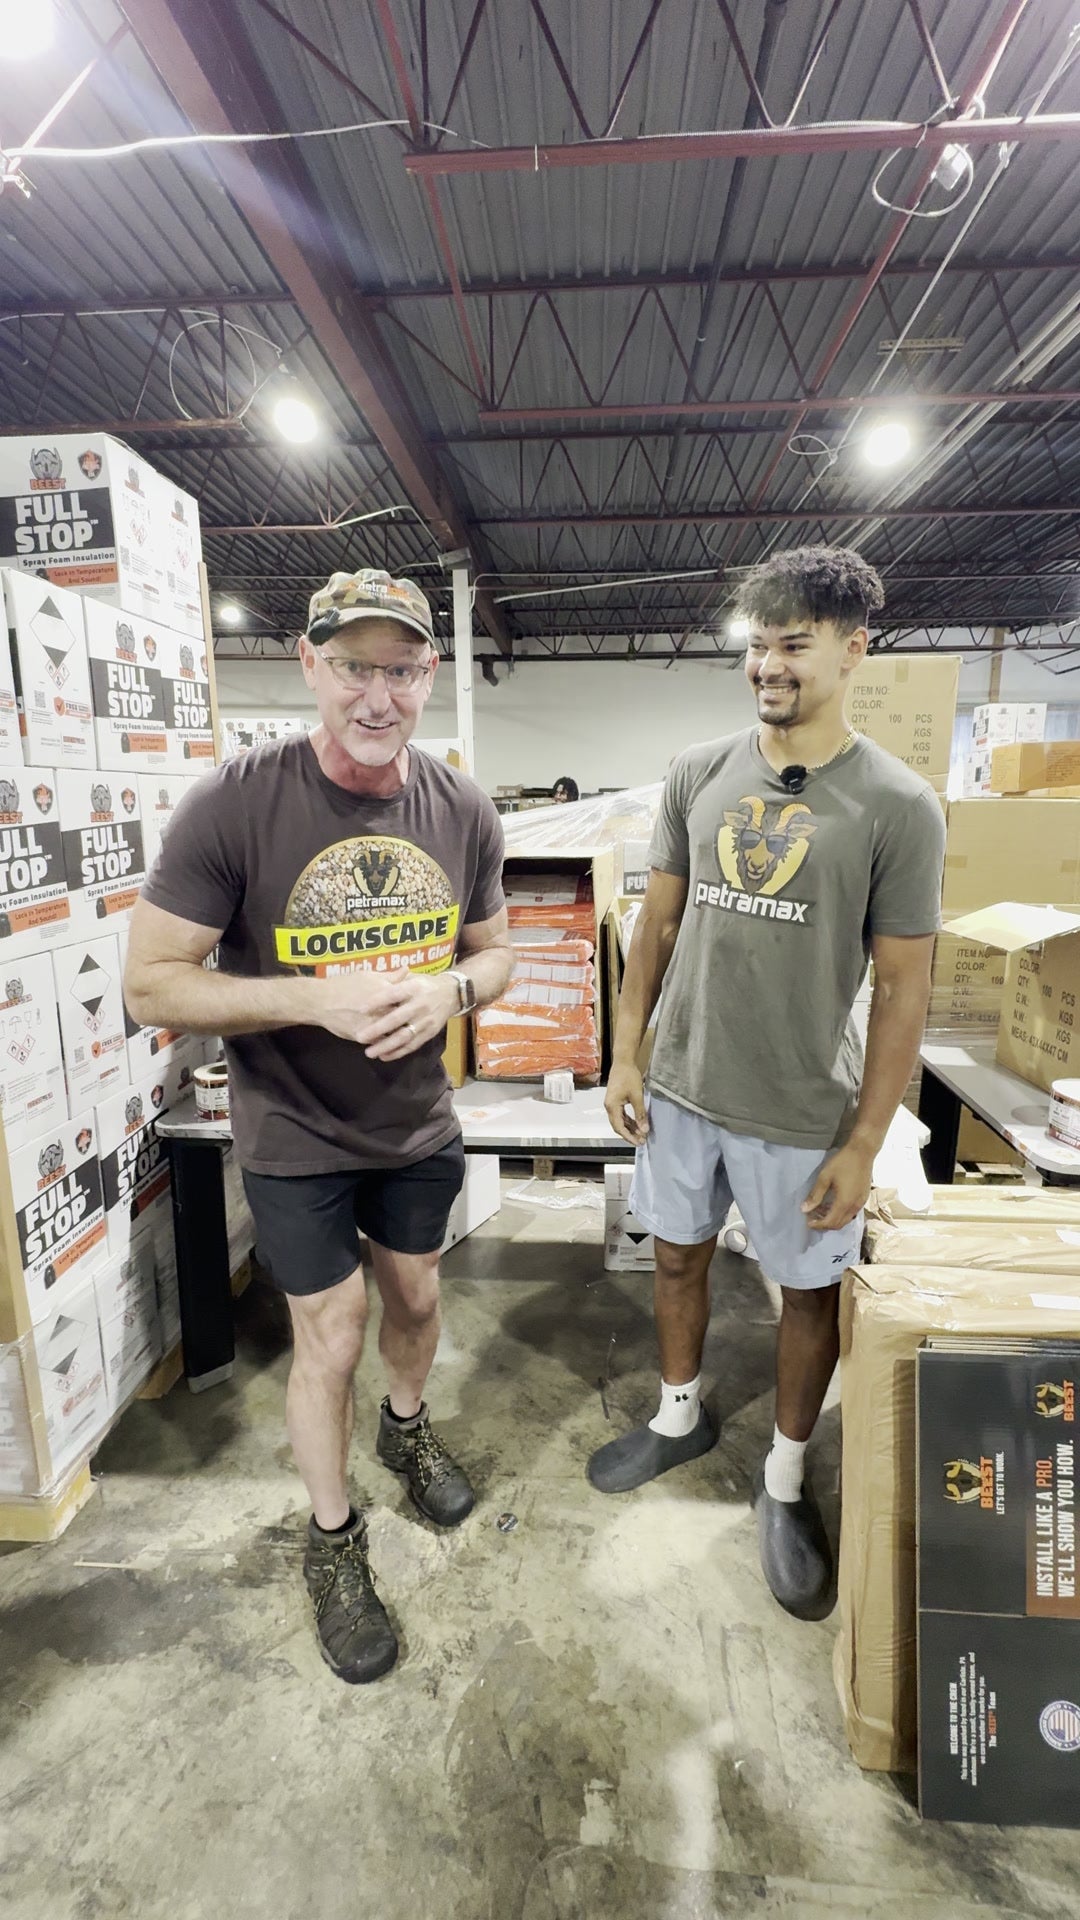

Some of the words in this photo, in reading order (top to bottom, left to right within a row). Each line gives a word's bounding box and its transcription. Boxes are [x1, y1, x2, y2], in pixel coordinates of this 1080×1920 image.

[30, 479, 66, 490] BEEST
[15, 492, 88, 524] FULL
[23, 557, 46, 568] Spray
[49, 556, 70, 564] Foam
[72, 552, 115, 562] Insulation
[76, 567, 114, 576] Temperature
[106, 662, 150, 692] FULL
[173, 680, 206, 705] FULL
[854, 686, 873, 696] ITEM
[888, 714, 902, 724] 100
[915, 714, 932, 724] PCS
[914, 728, 932, 737] KGS
[912, 742, 930, 752] KGS
[916, 756, 929, 765] CM
[0, 811, 22, 824] EEST
[90, 811, 114, 822] BEEST
[80, 824, 128, 856] FULL
[9, 897, 29, 906] Foam
[31, 887, 67, 900] Insulation
[88, 888, 104, 898] Spray
[104, 884, 118, 892] Foam
[120, 876, 144, 888] Insulation
[35, 902, 67, 914] Temperature
[347, 894, 406, 910] petramax
[696, 882, 808, 923] petramax
[326, 960, 373, 977] Mulch
[376, 956, 387, 972] &
[391, 950, 424, 968] Rock
[428, 944, 450, 961] Glue
[957, 949, 976, 958] ITEM
[992, 976, 1004, 985] 100
[1062, 991, 1076, 1007] PCS
[1059, 1010, 1074, 1026] KGS
[1012, 1026, 1028, 1040] MEAS:
[1057, 1048, 1068, 1063] CM
[1056, 1028, 1071, 1044] KGS
[117, 1122, 158, 1170] FULL
[38, 1164, 66, 1191] BEEST
[25, 1172, 84, 1234] FULL
[33, 1254, 52, 1273] Spray
[54, 1238, 72, 1254] Foam
[72, 1212, 102, 1240] Insulation
[1064, 1380, 1074, 1422] BEEST
[996, 1452, 1004, 1472] WORK.
[1056, 1440, 1074, 1475] HOW.
[996, 1474, 1004, 1482] TO
[1036, 1456, 1052, 1488] PRO.
[980, 1456, 994, 1509] BEEST
[996, 1483, 1004, 1496] GET
[1036, 1492, 1053, 1500] A
[1057, 1478, 1075, 1507] YOU
[996, 1497, 1005, 1515] LET'S
[1036, 1505, 1053, 1536] LIKE
[1058, 1508, 1075, 1552] SHOW
[1036, 1540, 1054, 1597] INSTALL
[1058, 1556, 1076, 1598] WE'LL
[988, 1692, 996, 1709] Team
[950, 1724, 958, 1754] WELCOME
[988, 1735, 996, 1747] The
